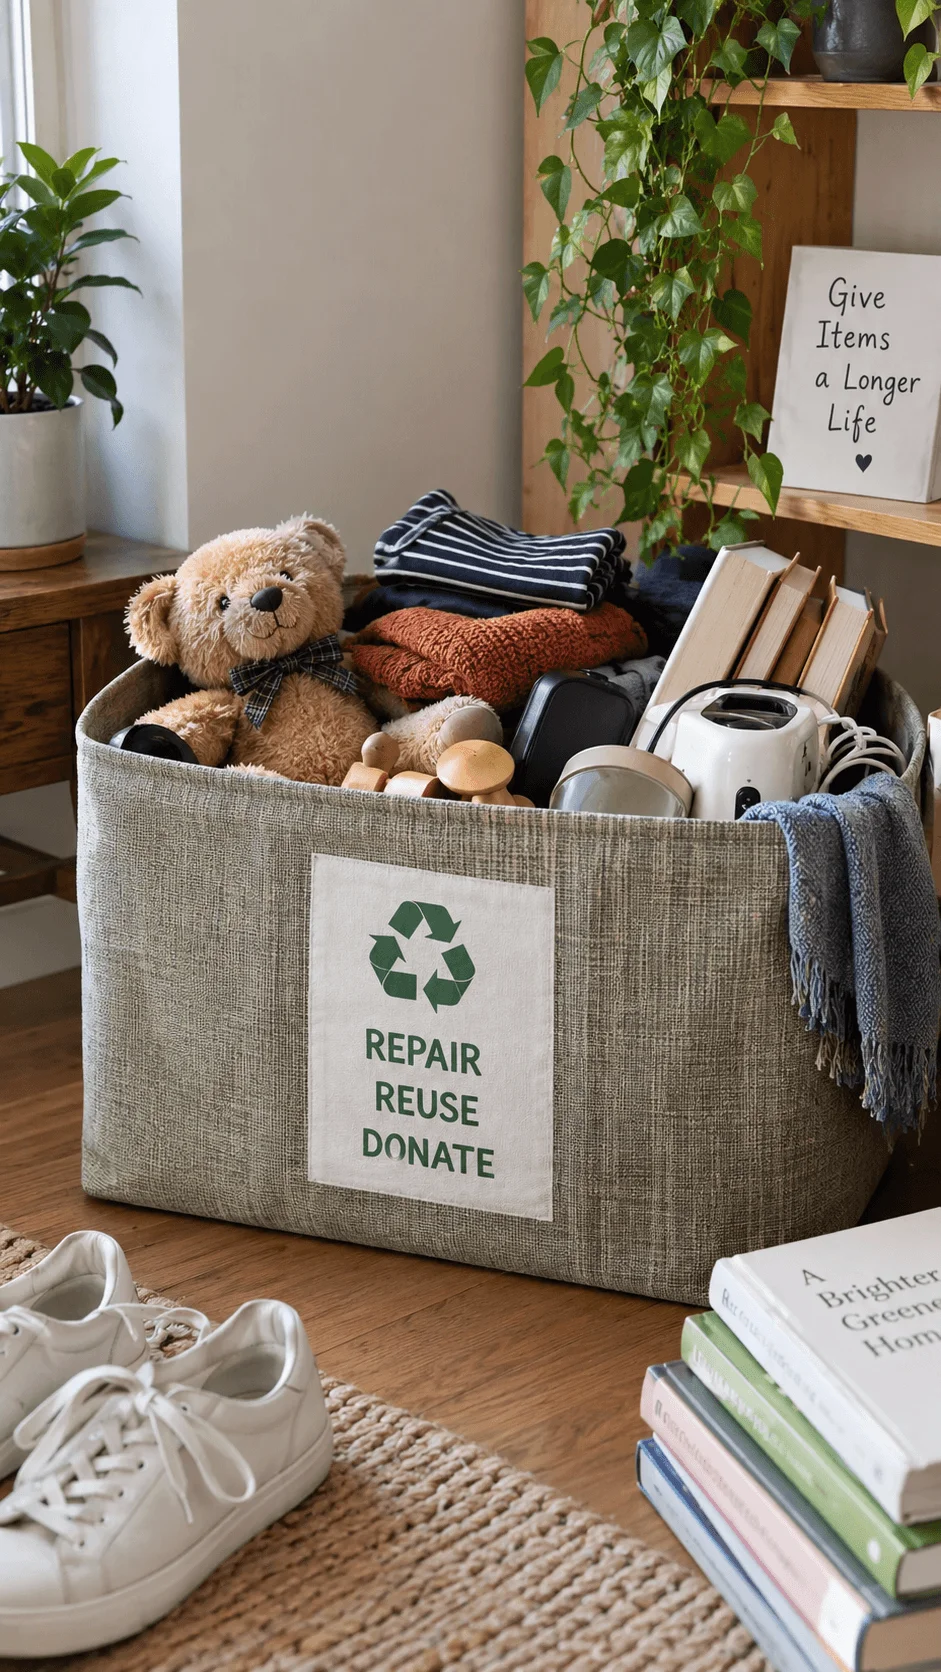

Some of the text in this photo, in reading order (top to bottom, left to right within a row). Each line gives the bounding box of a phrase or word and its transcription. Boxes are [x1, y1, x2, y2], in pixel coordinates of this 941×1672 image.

[828, 276, 886, 316] Give
[816, 320, 890, 351] Items
[815, 363, 921, 406] a Longer
[827, 403, 877, 443] Life
[366, 1028, 482, 1077] REPAIR
[375, 1081, 479, 1127] REUSE
[363, 1127, 495, 1179] DONATE
[802, 1268, 826, 1286] A
[817, 1269, 940, 1309] Brighter
